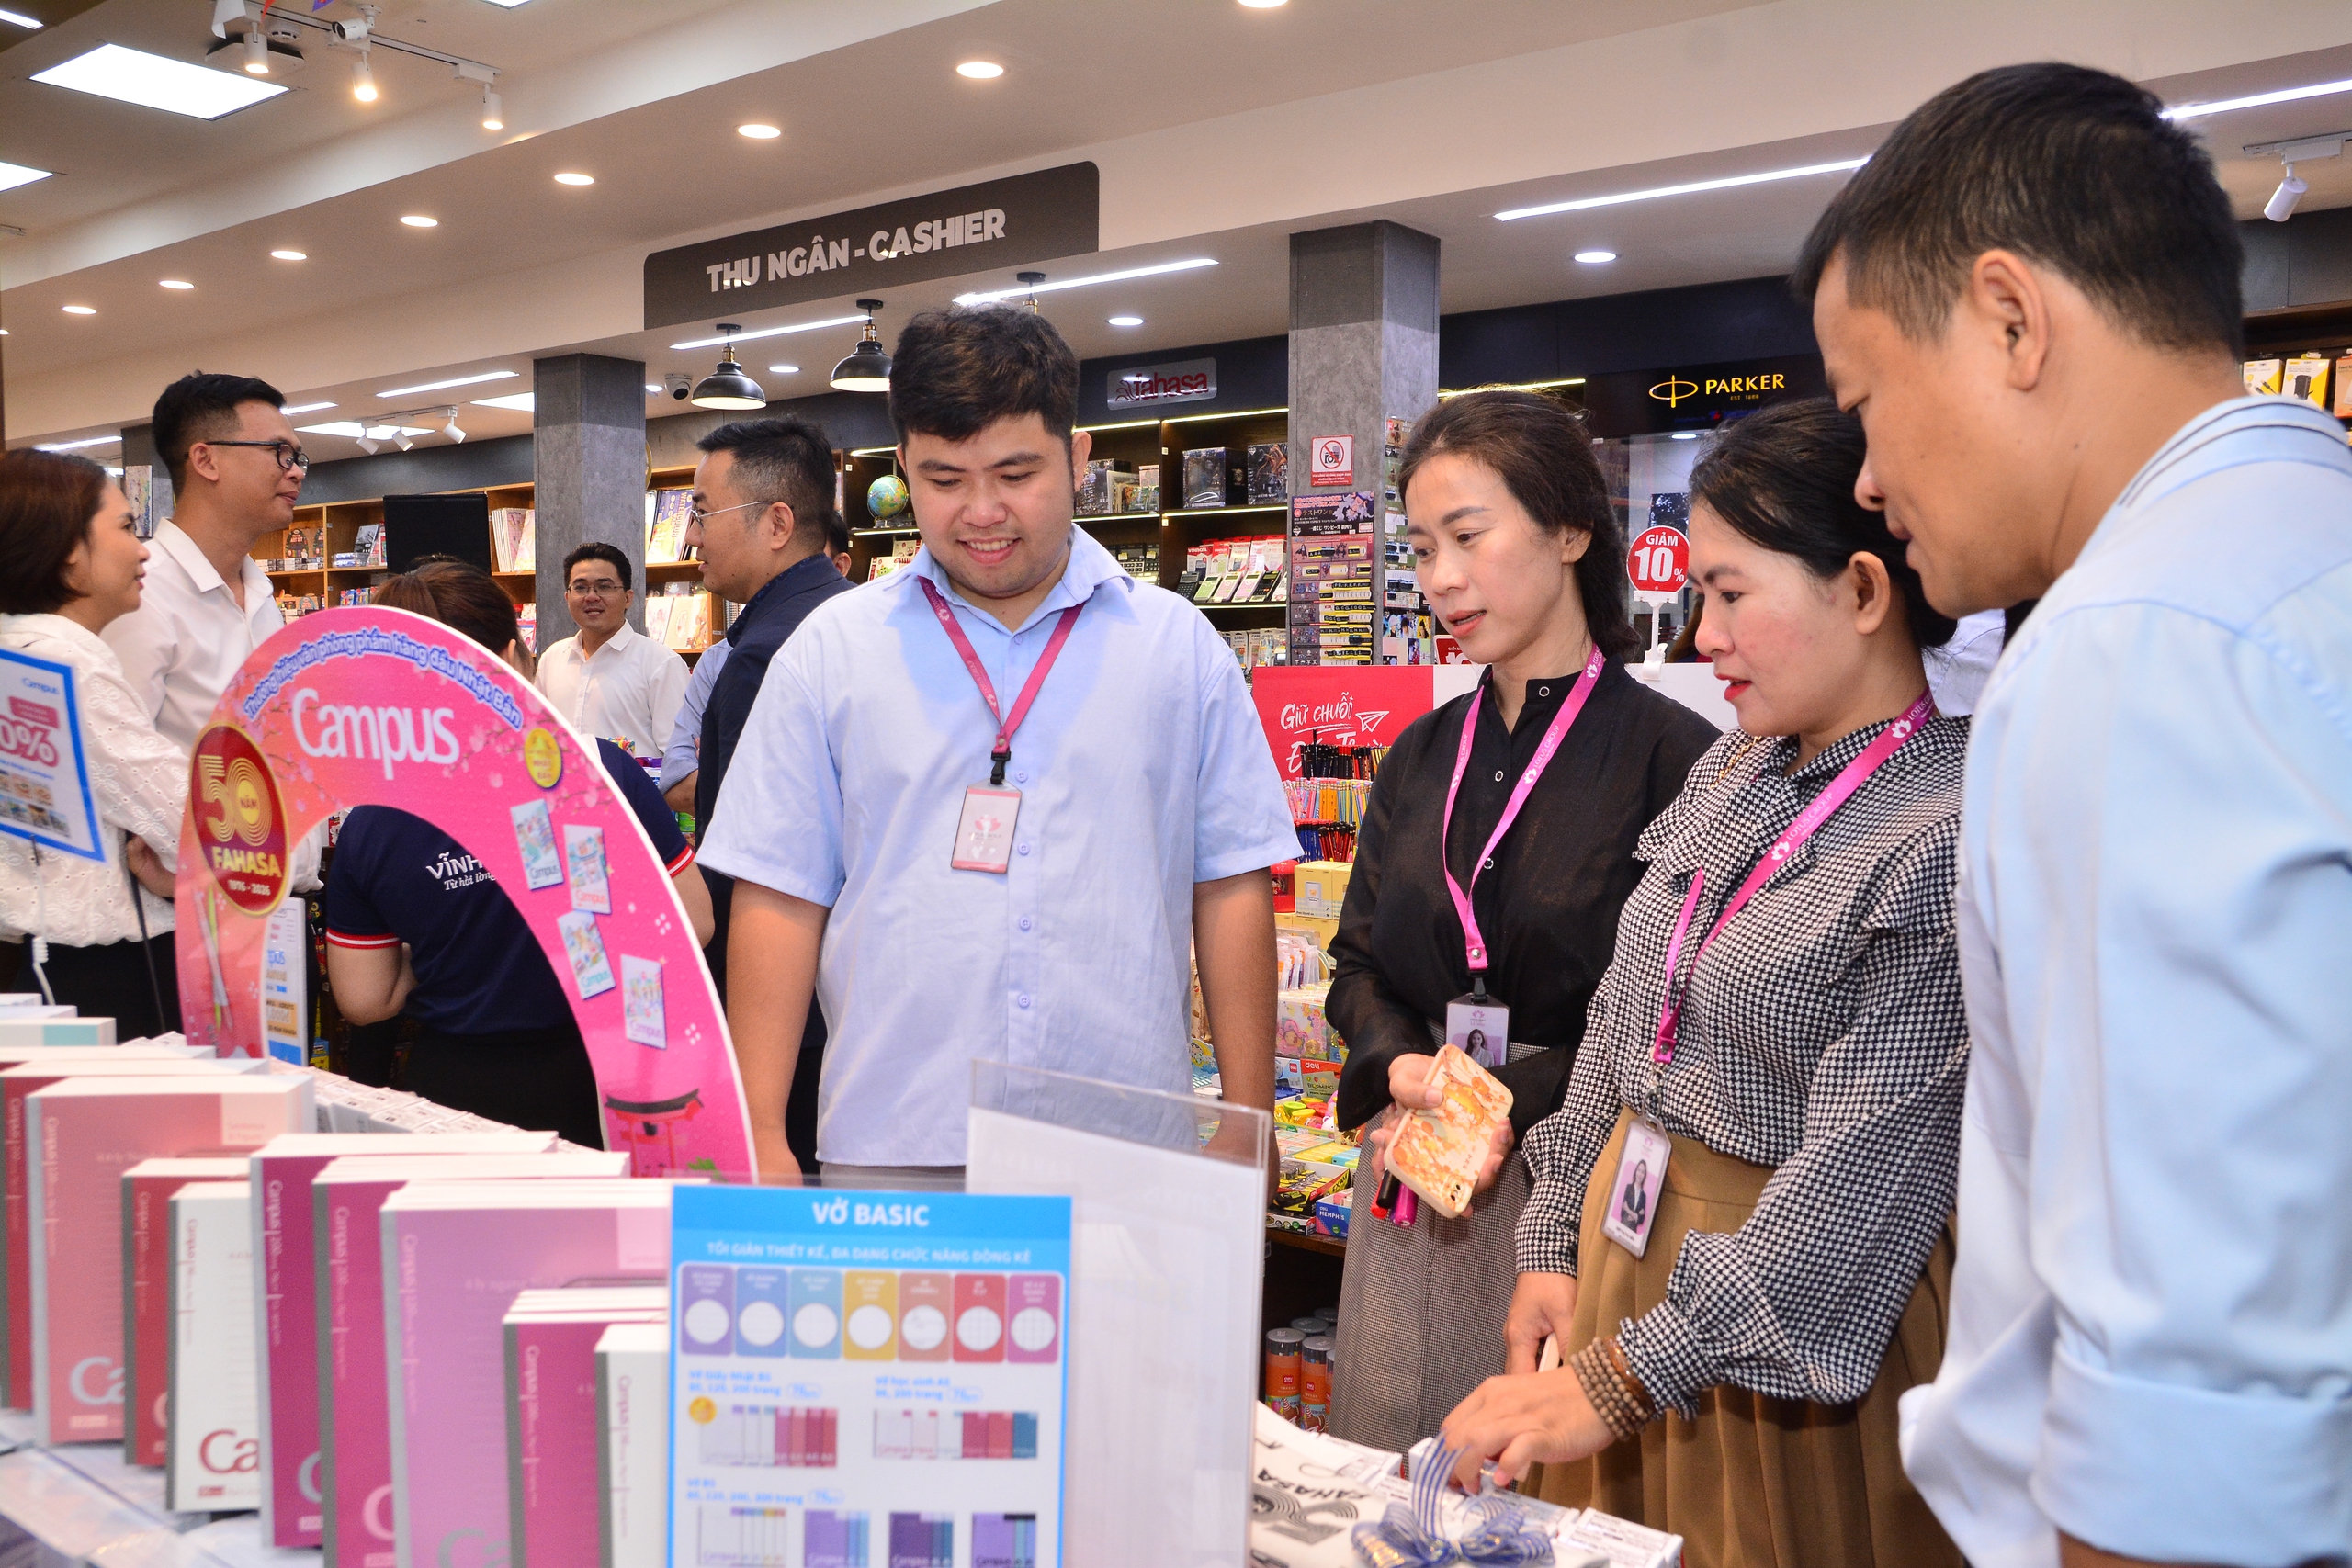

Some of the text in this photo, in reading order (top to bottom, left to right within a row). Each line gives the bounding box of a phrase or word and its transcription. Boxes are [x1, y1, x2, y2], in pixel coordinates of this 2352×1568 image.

[707, 256, 761, 292] THU
[768, 235, 849, 281] NGÂN
[869, 208, 1006, 262] CASHIER
[1705, 373, 1785, 395] PARKER
[1645, 532, 1679, 547] GIẢM
[1907, 701, 1927, 721] LOTUS
[291, 688, 459, 781] Campus
[1533, 725, 1560, 768] LOTUS GROUP
[1786, 792, 1833, 841] LOTUS GROUP
[212, 845, 282, 878] FAHASA
[575, 889, 606, 905] Campus
[581, 970, 611, 989] Campus
[629, 1020, 662, 1041] Campus
[1305, 1062, 1320, 1070] deli
[812, 1197, 931, 1227] VỞ BASIC
[1319, 1211, 1345, 1221] MEMPHIS
